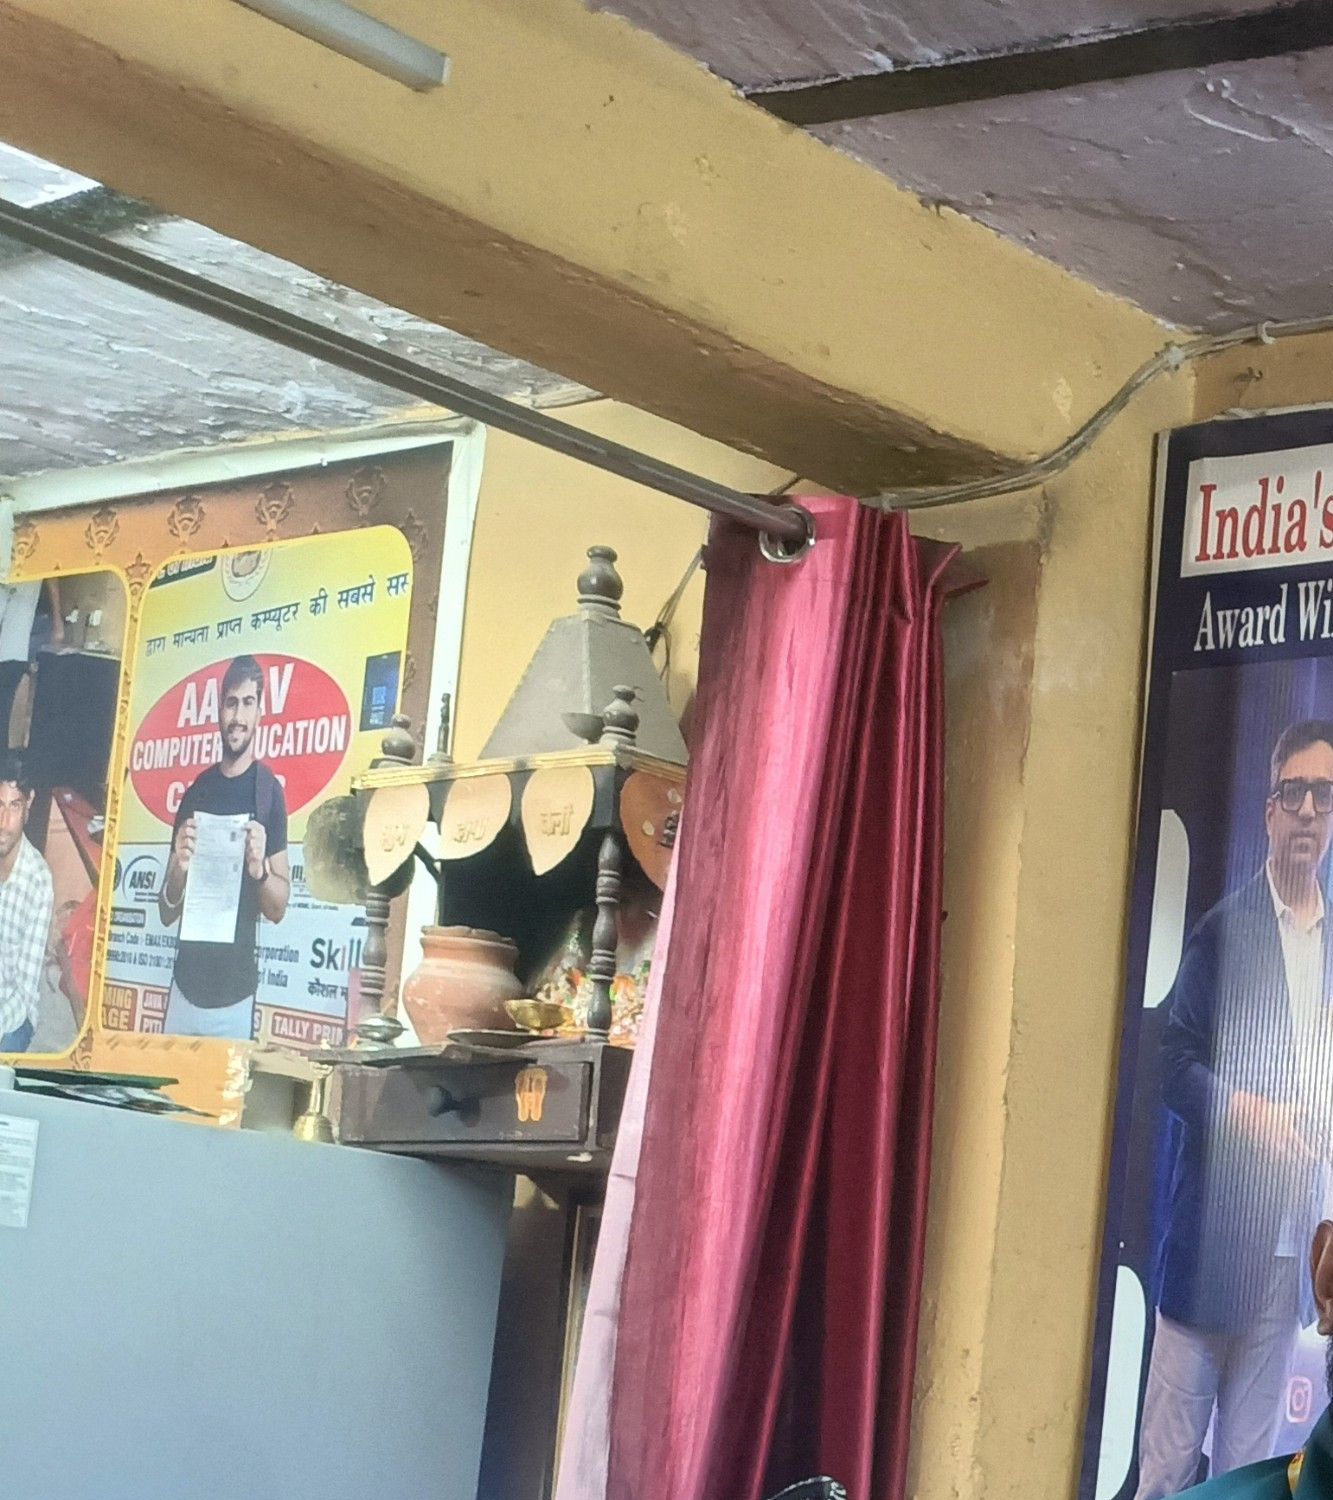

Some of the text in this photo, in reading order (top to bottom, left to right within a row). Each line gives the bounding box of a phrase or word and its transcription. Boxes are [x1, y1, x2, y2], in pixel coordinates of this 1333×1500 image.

[309, 588, 328, 616] की
[338, 575, 375, 608] सबसे
[1194, 582, 1288, 653] Award
[177, 663, 295, 728] AAV
[253, 714, 347, 760] UCATION
[129, 870, 157, 890] ANSI
[274, 1014, 310, 1037] TALLY
